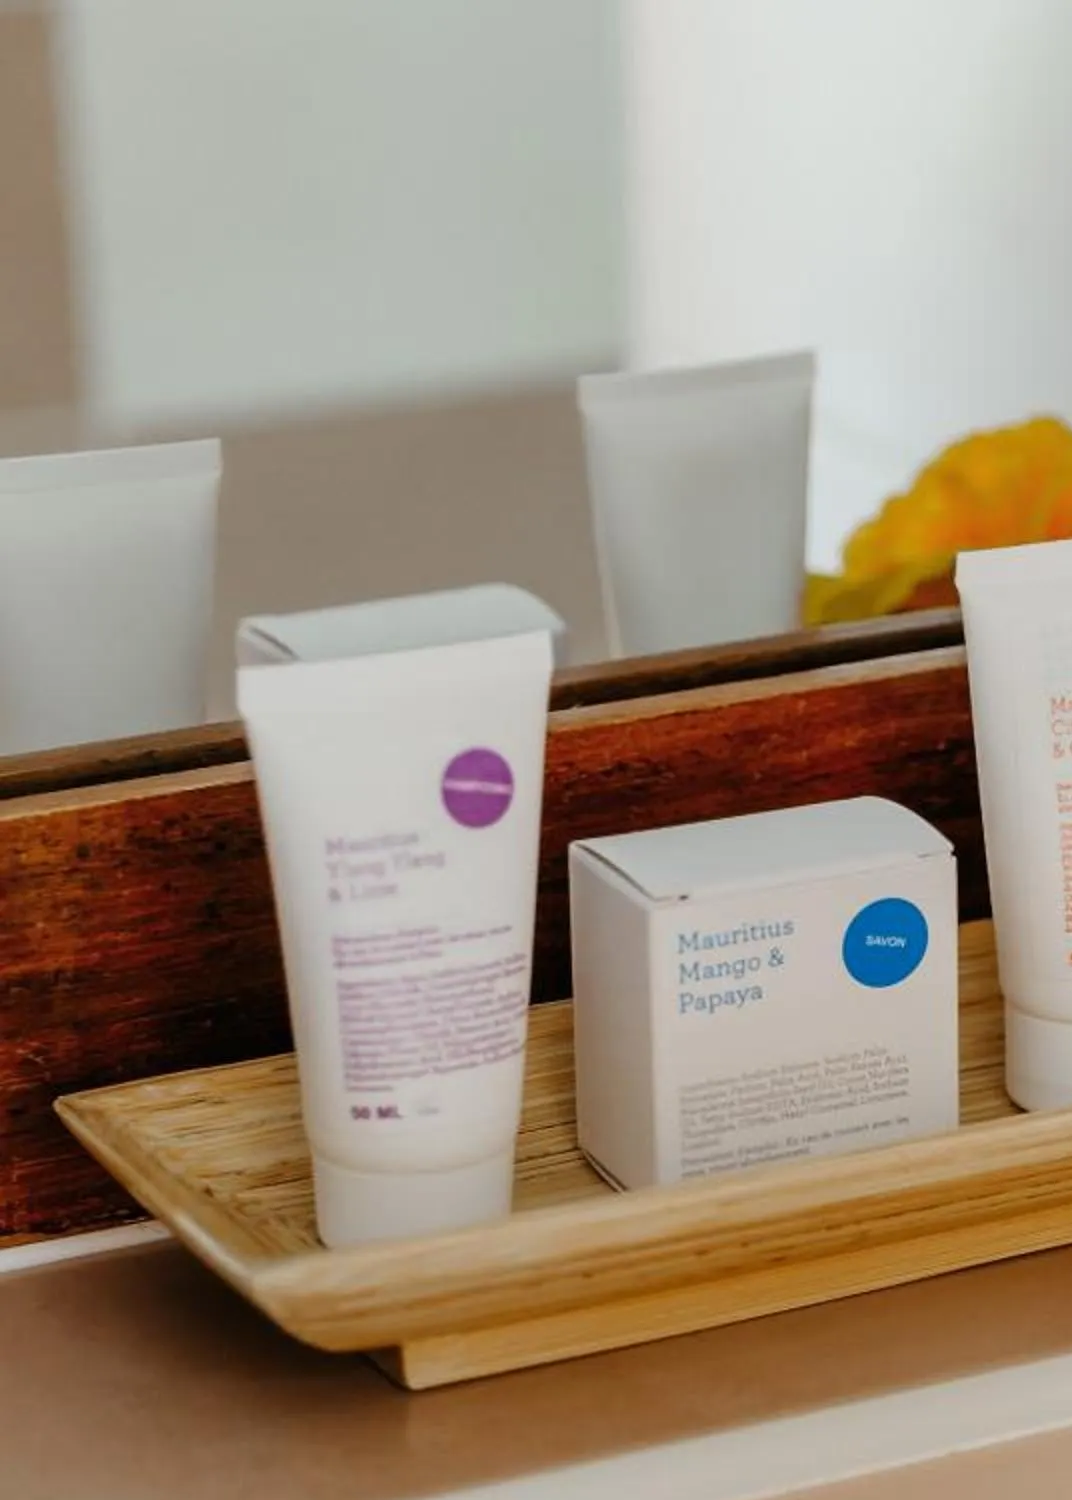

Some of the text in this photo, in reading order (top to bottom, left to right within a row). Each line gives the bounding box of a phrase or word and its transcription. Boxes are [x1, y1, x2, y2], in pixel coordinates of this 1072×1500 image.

[678, 919, 795, 954] Mauritius
[864, 934, 908, 949] SAVON
[678, 946, 785, 986] Mango &
[678, 983, 764, 1015] Papaya
